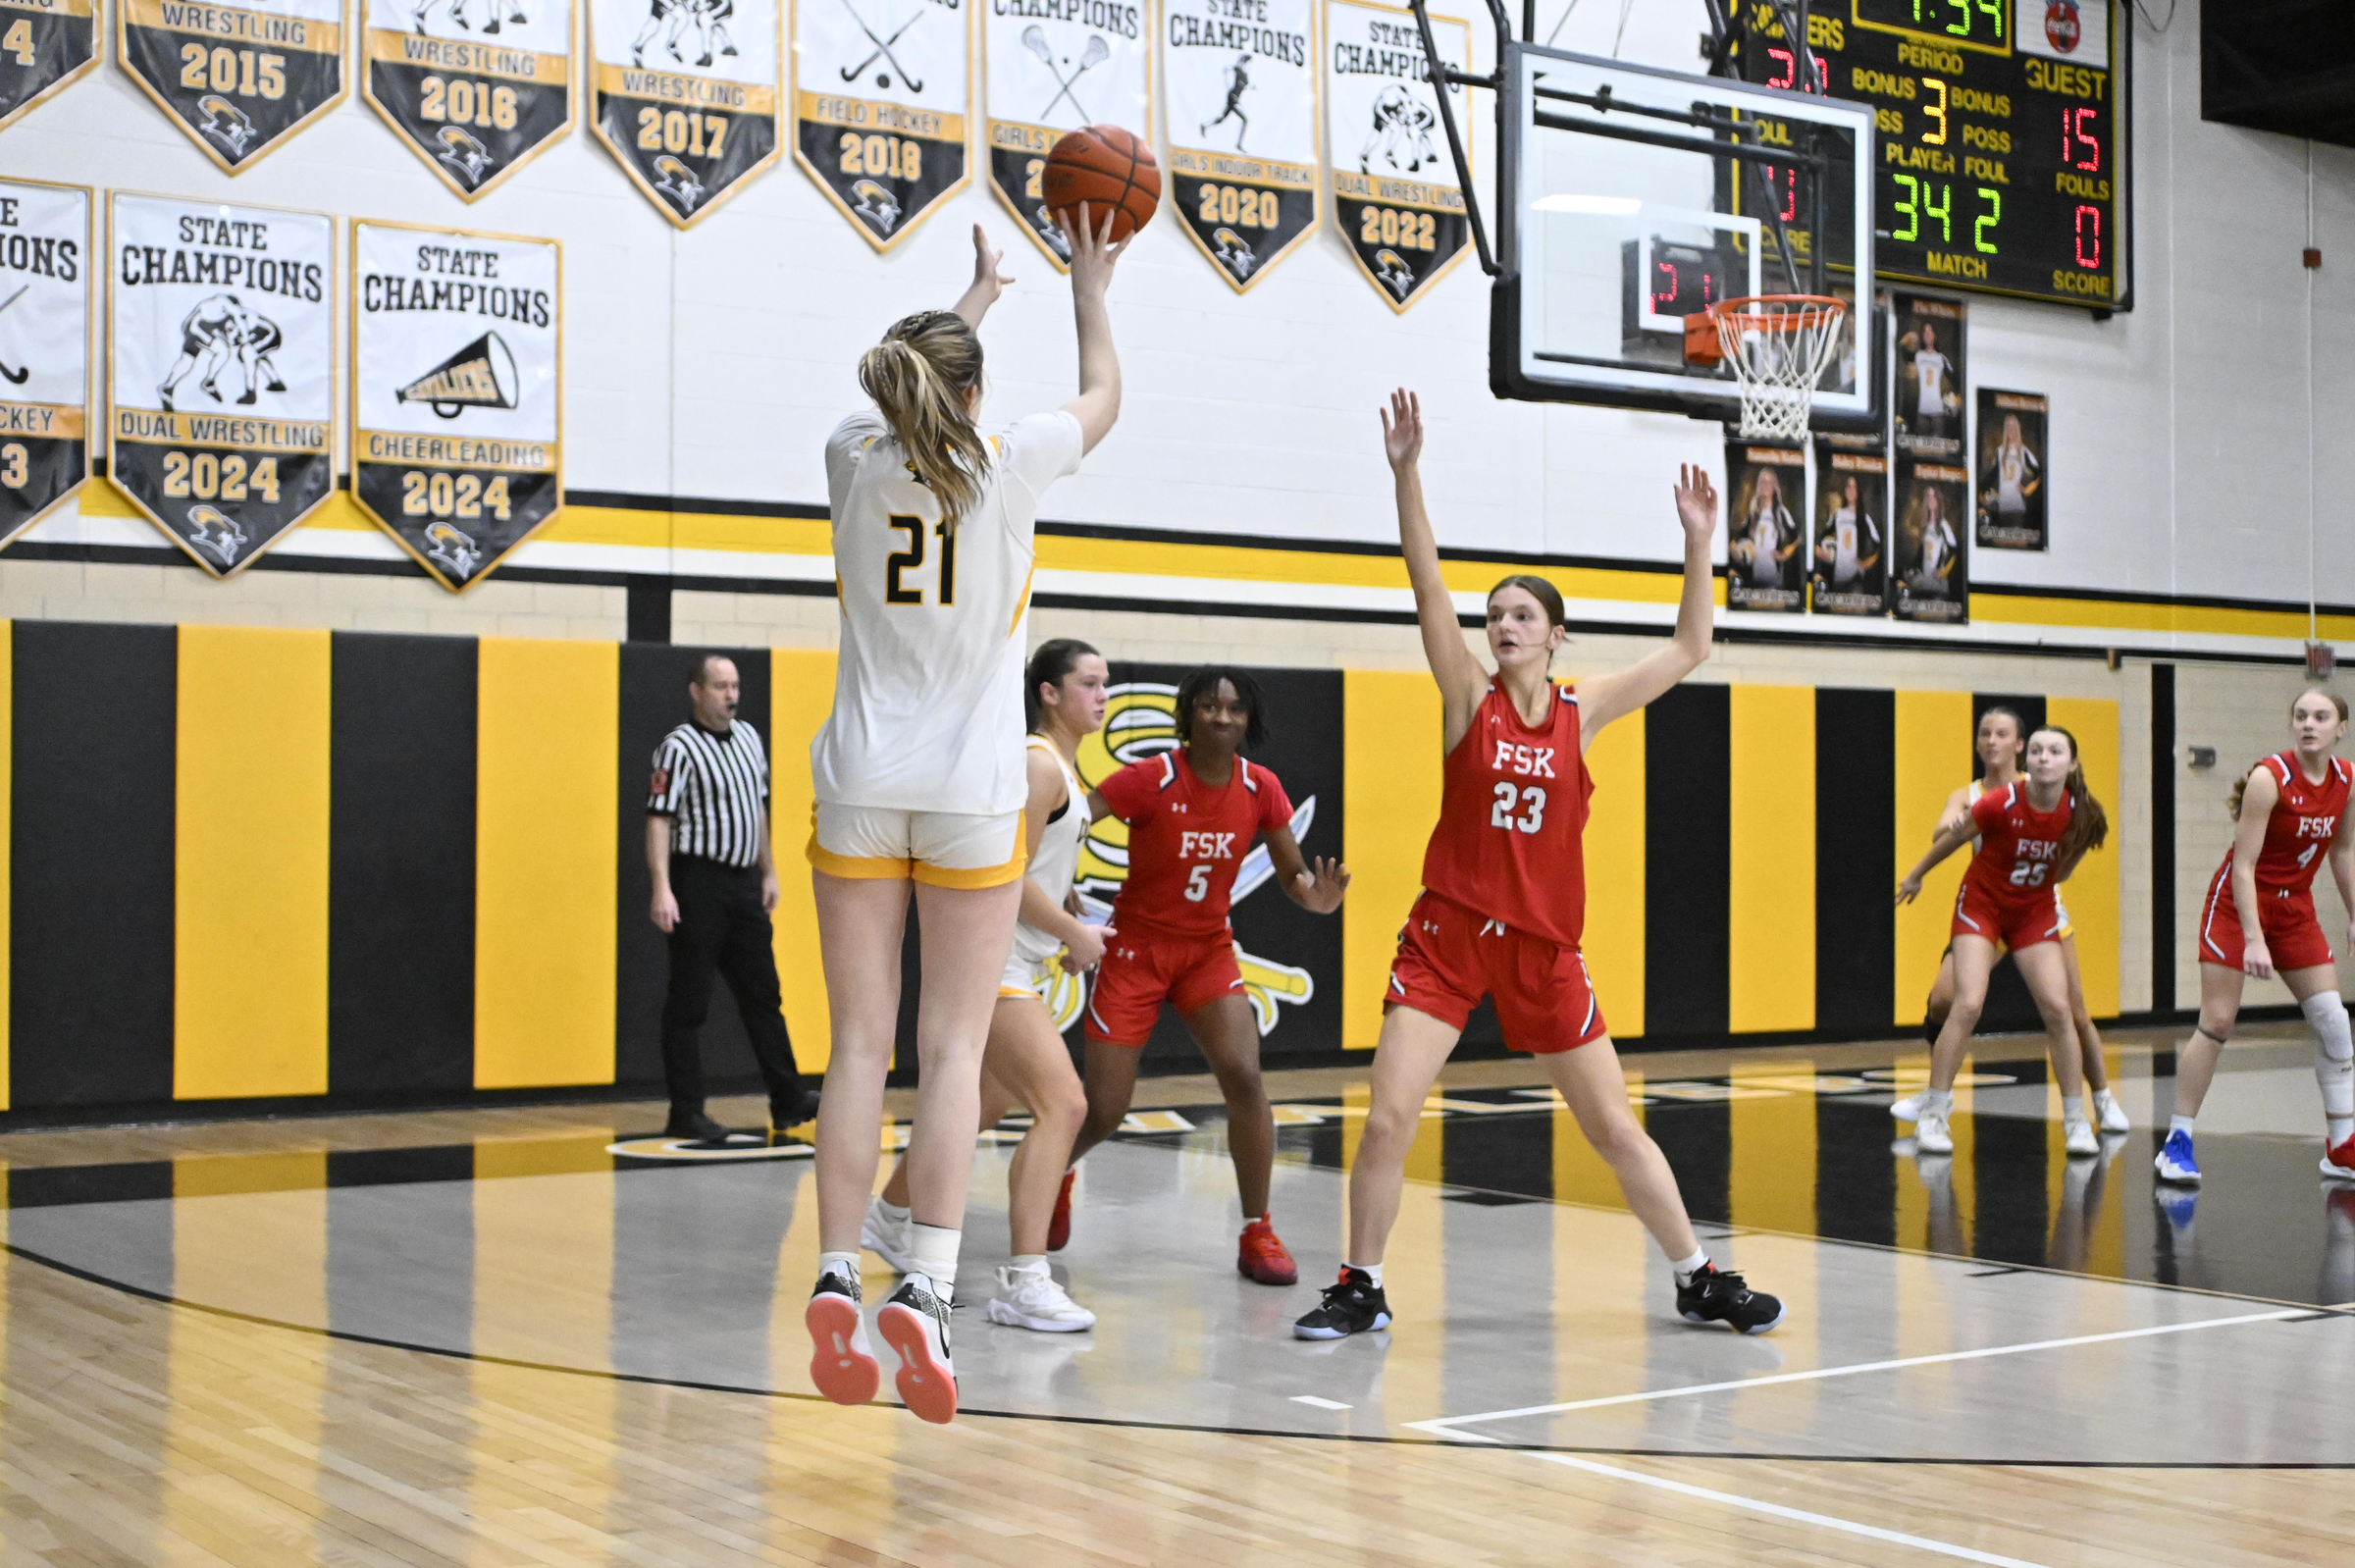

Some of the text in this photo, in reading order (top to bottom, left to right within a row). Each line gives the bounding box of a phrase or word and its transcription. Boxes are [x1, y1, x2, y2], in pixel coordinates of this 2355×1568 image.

[161, 2, 306, 45] WRESTLING
[1208, 0, 1269, 23] STATE
[403, 35, 536, 77] WRESTLING
[1170, 14, 1305, 67] CHAMPIONS
[1898, 42, 1963, 76] PERIOD
[181, 42, 286, 99] 2015
[1334, 41, 1461, 93] CHAMPIS
[1852, 68, 1916, 100] BONUS
[2024, 57, 2107, 101] GUEST
[421, 77, 517, 130] 2016
[622, 71, 745, 107] WRESTLING
[1951, 86, 2011, 118] BONUS
[817, 98, 941, 134] FIELD HOCKEY
[1874, 109, 1904, 134] SS
[1922, 78, 1946, 145] 3
[638, 107, 728, 159] 2017
[993, 124, 1045, 149] GIRLS
[1962, 124, 2012, 155] POSS
[2063, 108, 2099, 172] 15
[840, 133, 921, 182] 2018
[1213, 159, 1263, 179] INDOOR
[1267, 164, 1311, 183] TRACK
[1886, 142, 2010, 183] PLAYER FOUL
[1334, 173, 1463, 208] DUAL WRESTLING
[2056, 172, 2109, 201] FOULS
[1199, 183, 1280, 231] 2020
[1893, 174, 1951, 243] 34
[1975, 187, 2000, 254] 2
[180, 214, 267, 250] STATE
[1361, 205, 1436, 251] 2022
[2075, 204, 2099, 269] 0
[122, 245, 323, 303] CHAMPIONS
[418, 245, 498, 279] STATE
[1926, 249, 1987, 280] MATCH
[364, 274, 550, 329] CHAMPIONS
[2053, 269, 2110, 296] SCORE
[121, 412, 324, 447] DUAL WRESTLING
[369, 434, 546, 469] CHEERLEADING
[163, 451, 281, 503] 2024
[402, 470, 511, 521] 2024
[885, 513, 957, 606] 21
[1492, 739, 1555, 778] FSK
[1491, 780, 1547, 834] 23
[2296, 815, 2335, 838] FSK
[1178, 831, 1236, 860] FSK
[2016, 838, 2058, 860] FSK
[2297, 843, 2319, 869] 4
[1183, 864, 1213, 903] 5
[2010, 861, 2048, 886] 25
